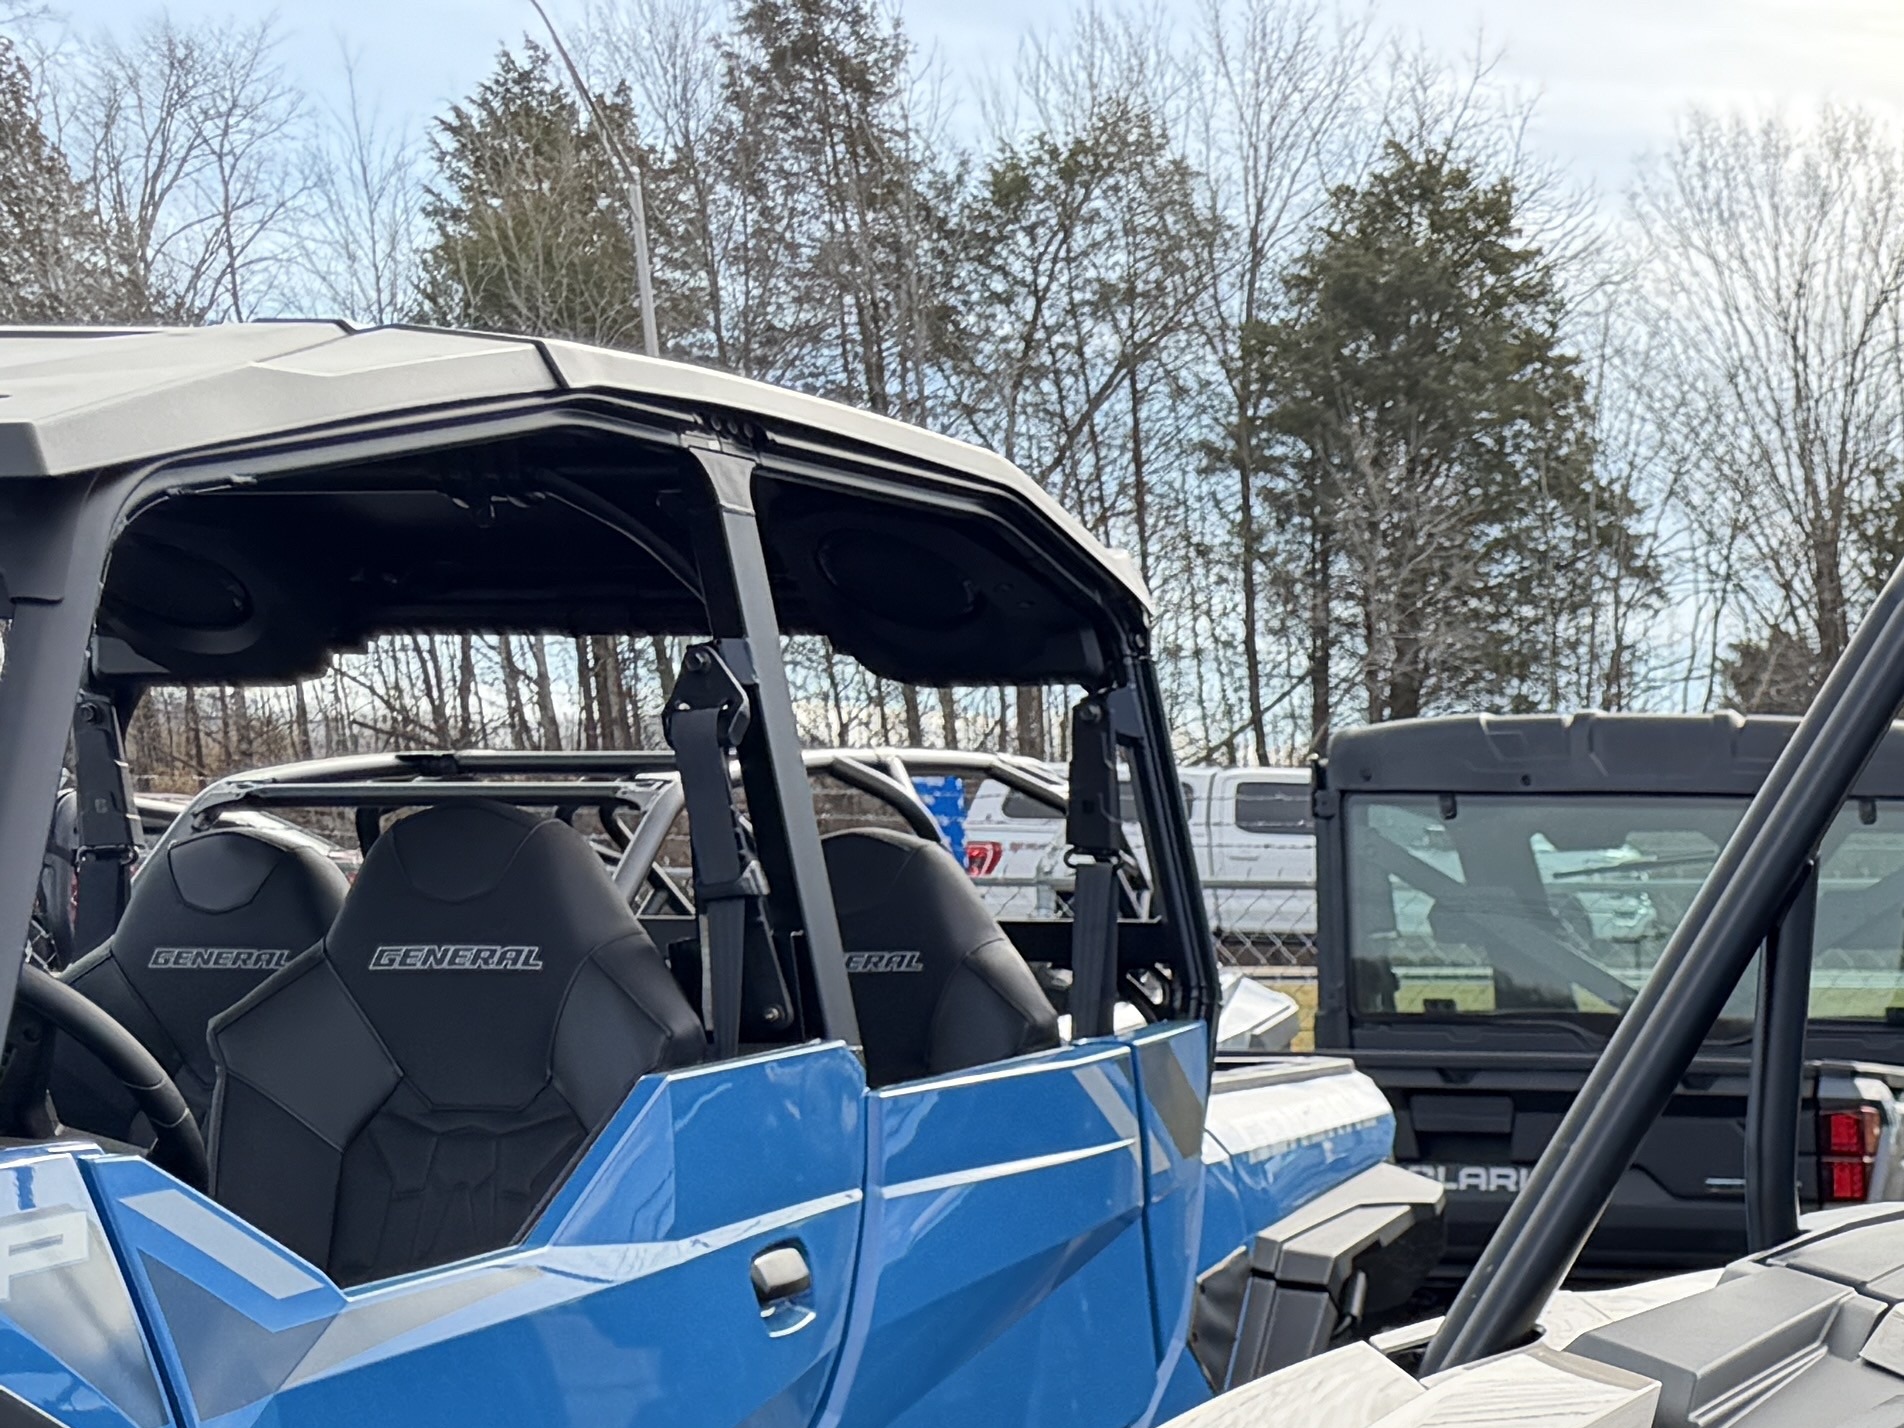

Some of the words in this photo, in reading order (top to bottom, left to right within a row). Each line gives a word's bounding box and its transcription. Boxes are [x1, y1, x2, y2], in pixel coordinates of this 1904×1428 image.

[148, 947, 292, 969] GENERAL
[368, 944, 543, 971] GENERAL
[843, 951, 924, 973] ERAL
